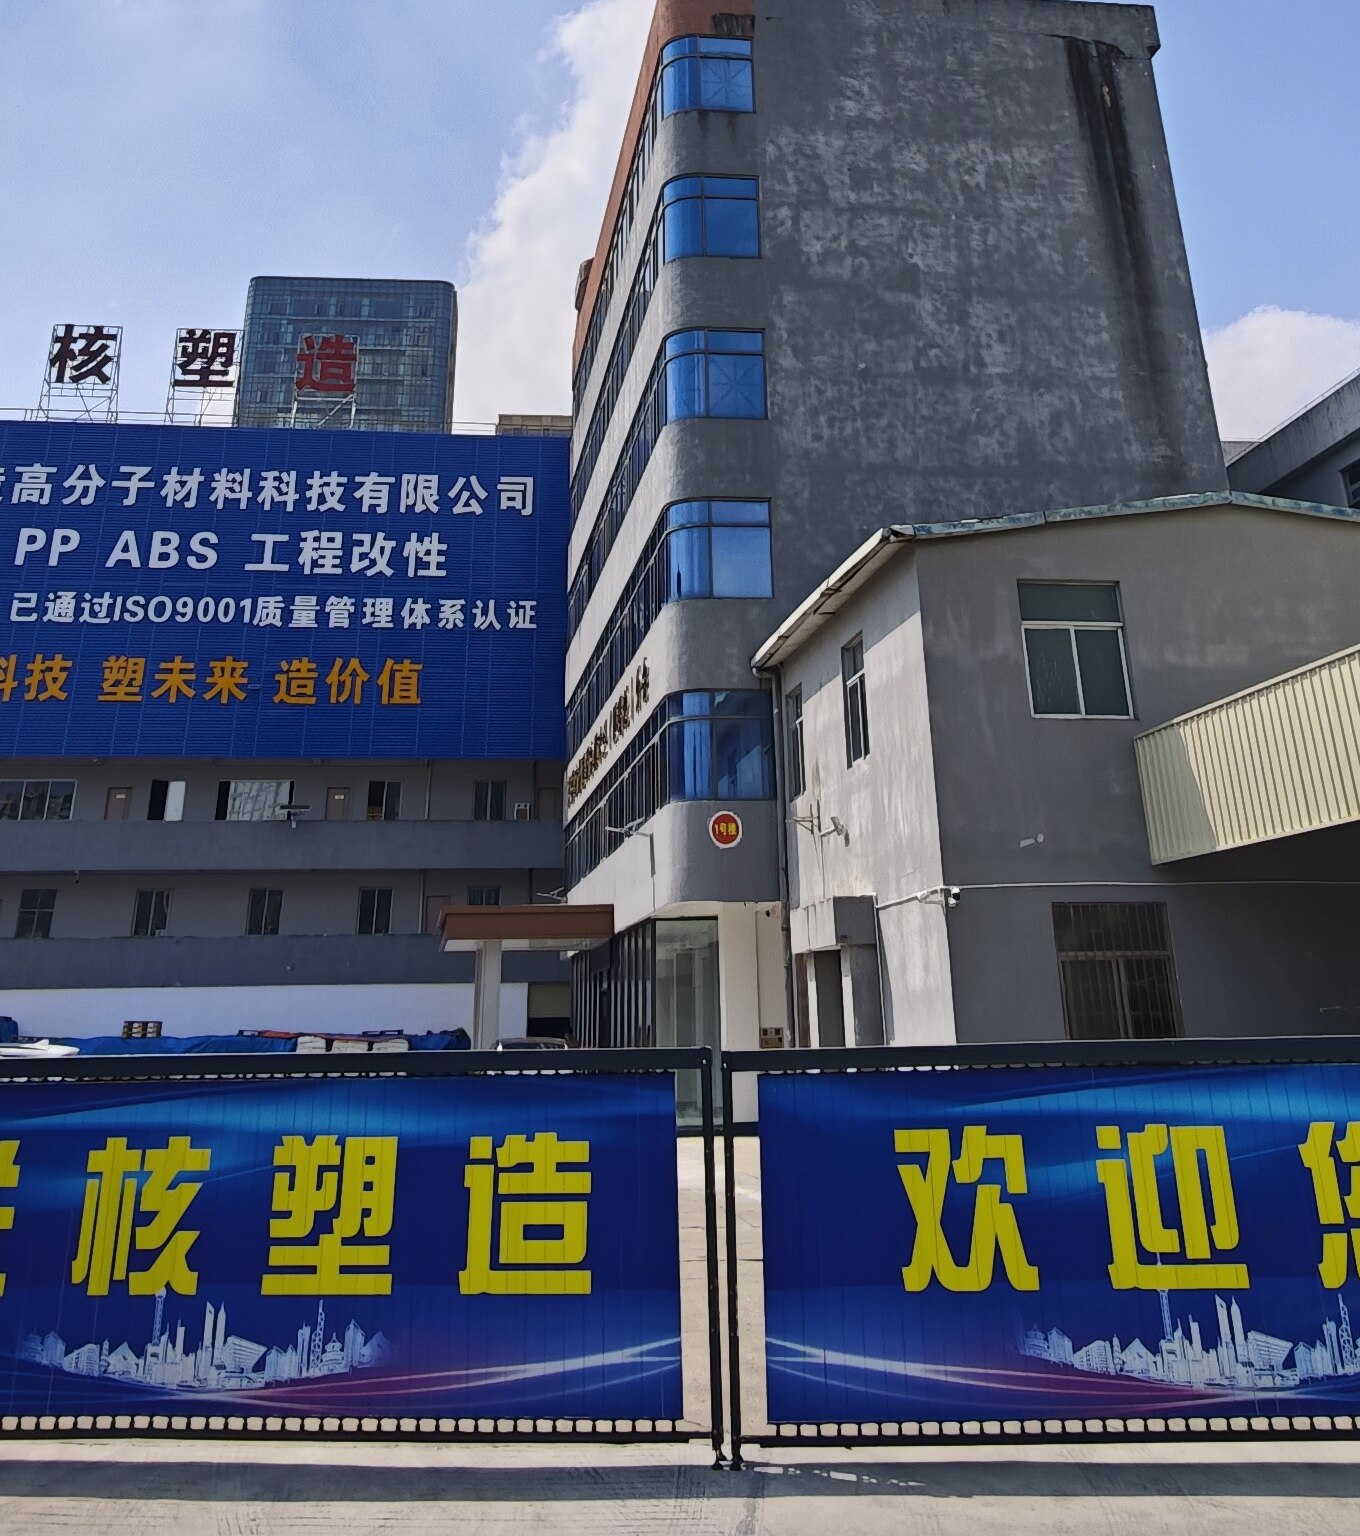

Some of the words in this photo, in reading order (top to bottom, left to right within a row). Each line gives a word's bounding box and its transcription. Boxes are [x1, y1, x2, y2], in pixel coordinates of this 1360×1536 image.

[14, 528, 80, 567] PP
[105, 530, 219, 571] ABS
[244, 531, 448, 578] 工程改性
[9, 591, 537, 631] 已通过ISO9001质量管理体系认证
[97, 655, 249, 705] 塑未来
[273, 657, 423, 705] 造价值
